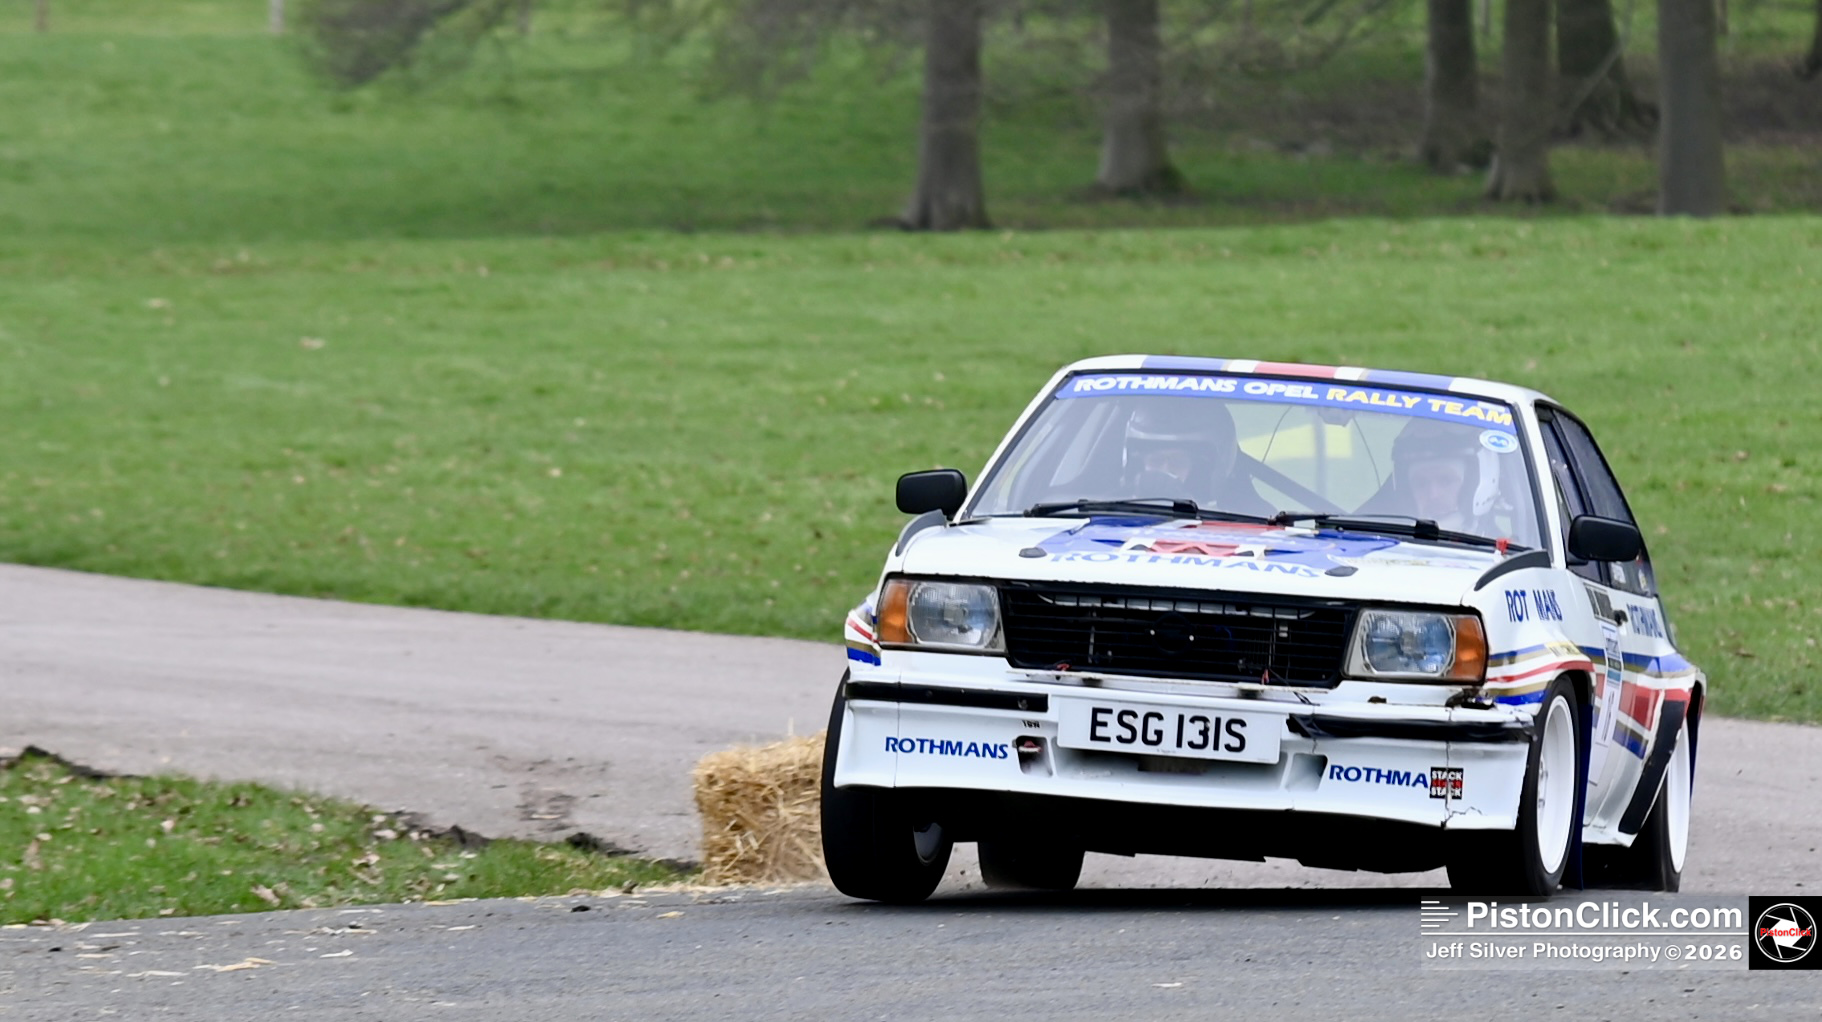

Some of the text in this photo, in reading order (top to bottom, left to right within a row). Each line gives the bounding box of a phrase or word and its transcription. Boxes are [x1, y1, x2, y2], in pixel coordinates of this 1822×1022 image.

[1073, 376, 1513, 426] ROTHMANS OPEL RALLY TEAM
[1050, 552, 1321, 578] ROTHMANS
[1089, 706, 1248, 753] ESG 131S
[885, 736, 1009, 760] ROTHMANS
[1329, 764, 1429, 789] ROTHMA
[1431, 770, 1463, 780] STACK
